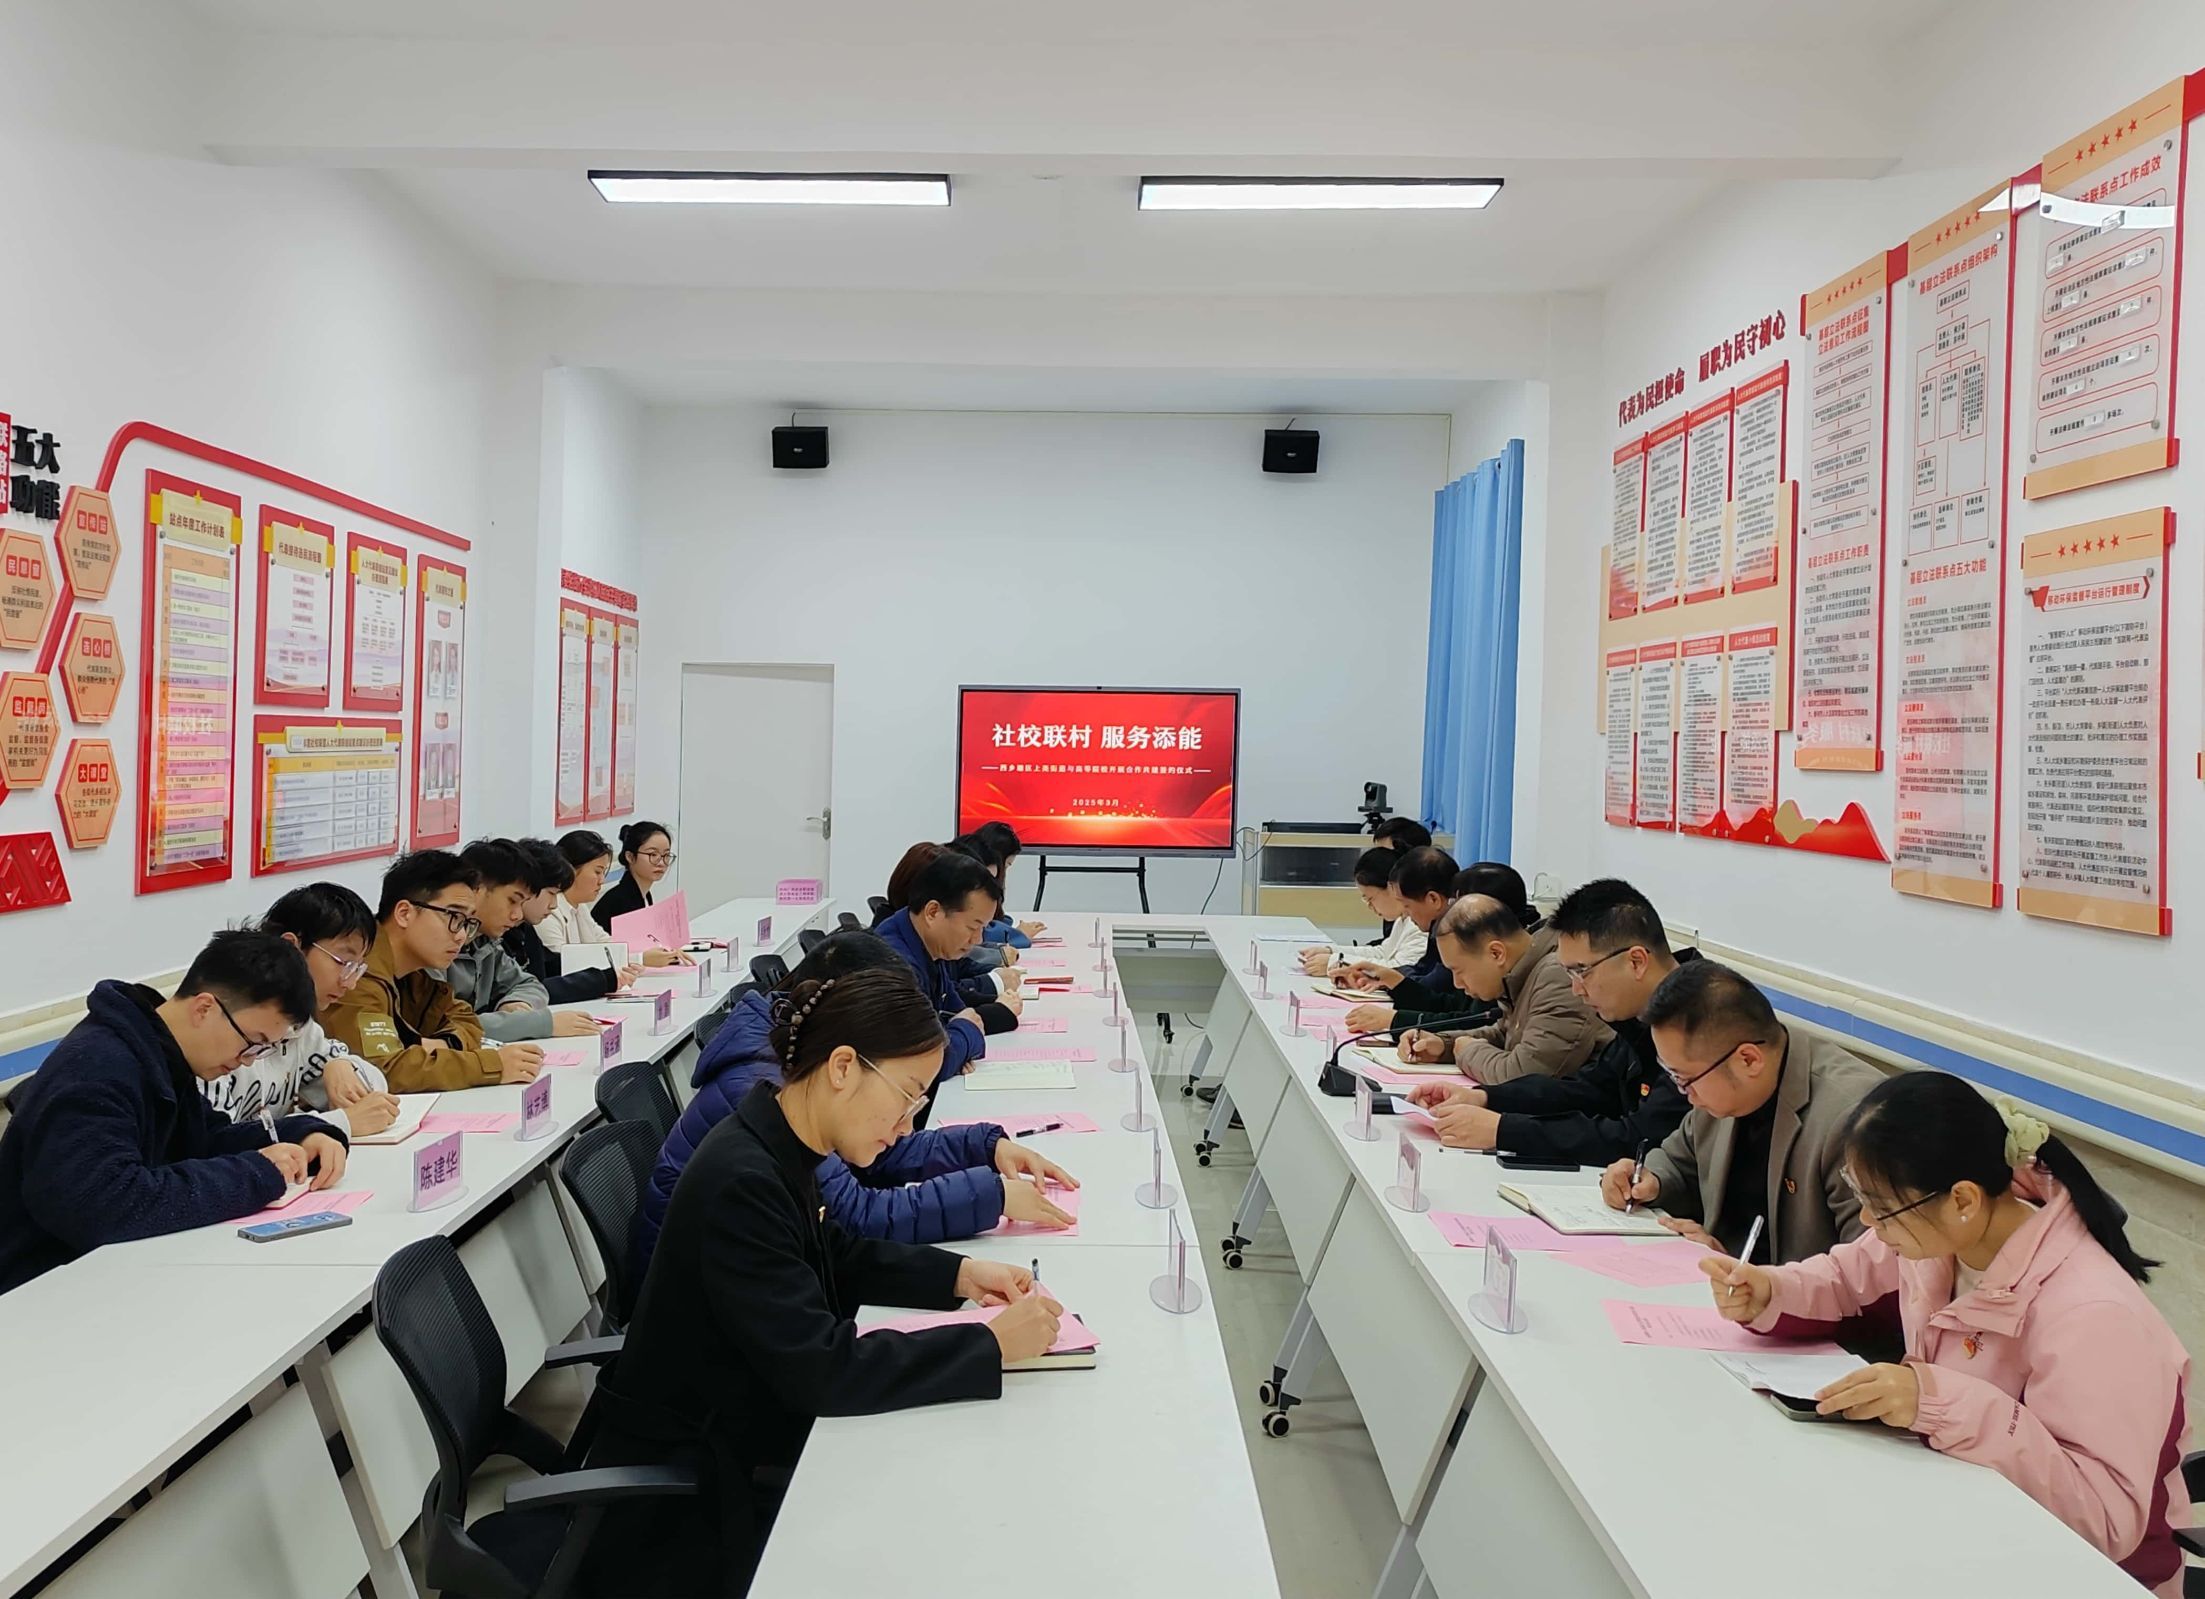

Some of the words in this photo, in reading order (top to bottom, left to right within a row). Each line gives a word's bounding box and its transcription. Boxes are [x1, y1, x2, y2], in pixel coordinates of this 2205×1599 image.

[2075, 154, 2161, 202] 法联系点工作成效
[1699, 310, 1786, 382] 履职为民守初心
[1619, 367, 1685, 428] 代表为民担使命
[10, 425, 61, 474] 五大
[9, 474, 60, 520] 功能
[992, 723, 1093, 749] 社校联村
[1101, 725, 1202, 751] 服务添能
[420, 1150, 459, 1191] 陈建华
